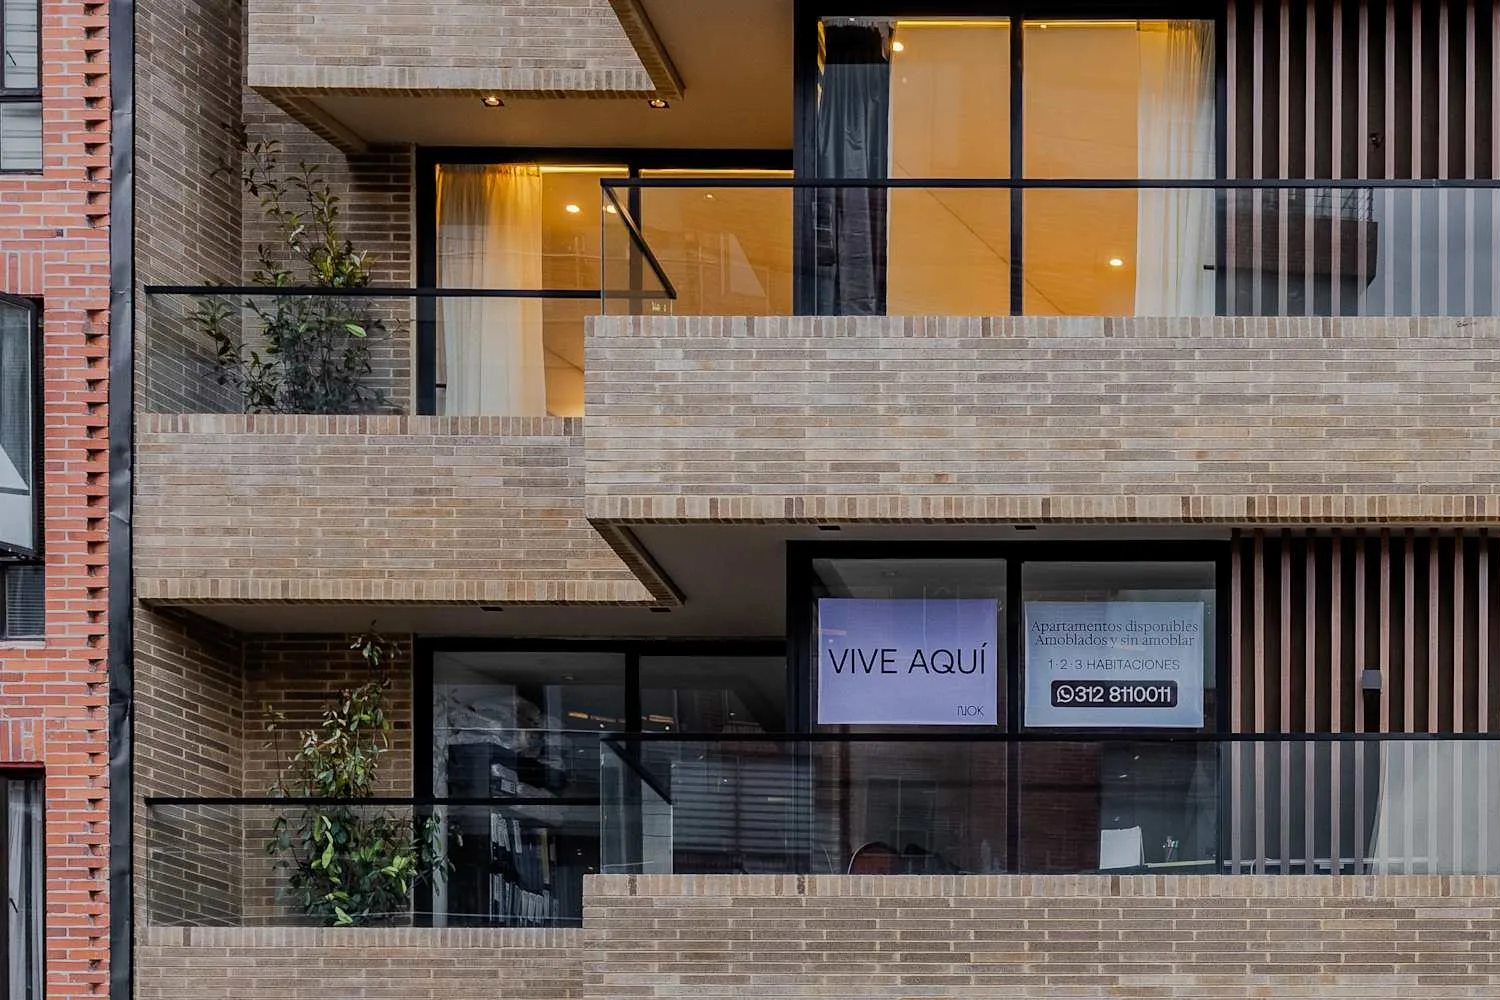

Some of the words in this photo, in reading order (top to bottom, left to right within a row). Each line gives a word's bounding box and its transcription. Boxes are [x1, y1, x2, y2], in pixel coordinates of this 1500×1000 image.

[1031, 621, 1122, 635] Apartamentos
[1125, 619, 1198, 635] disponibles
[1035, 634, 1108, 646] Amoblados
[1110, 637, 1119, 649] y
[1121, 635, 1138, 646] sin
[1142, 634, 1195, 646] amoblar
[828, 648, 897, 674] VIVE
[908, 642, 988, 675] AQUÍ
[1087, 659, 1180, 670] HABITACIONES
[1074, 686, 1104, 702] 312
[1109, 686, 1171, 702] 8110011
[957, 705, 985, 717] NOK
